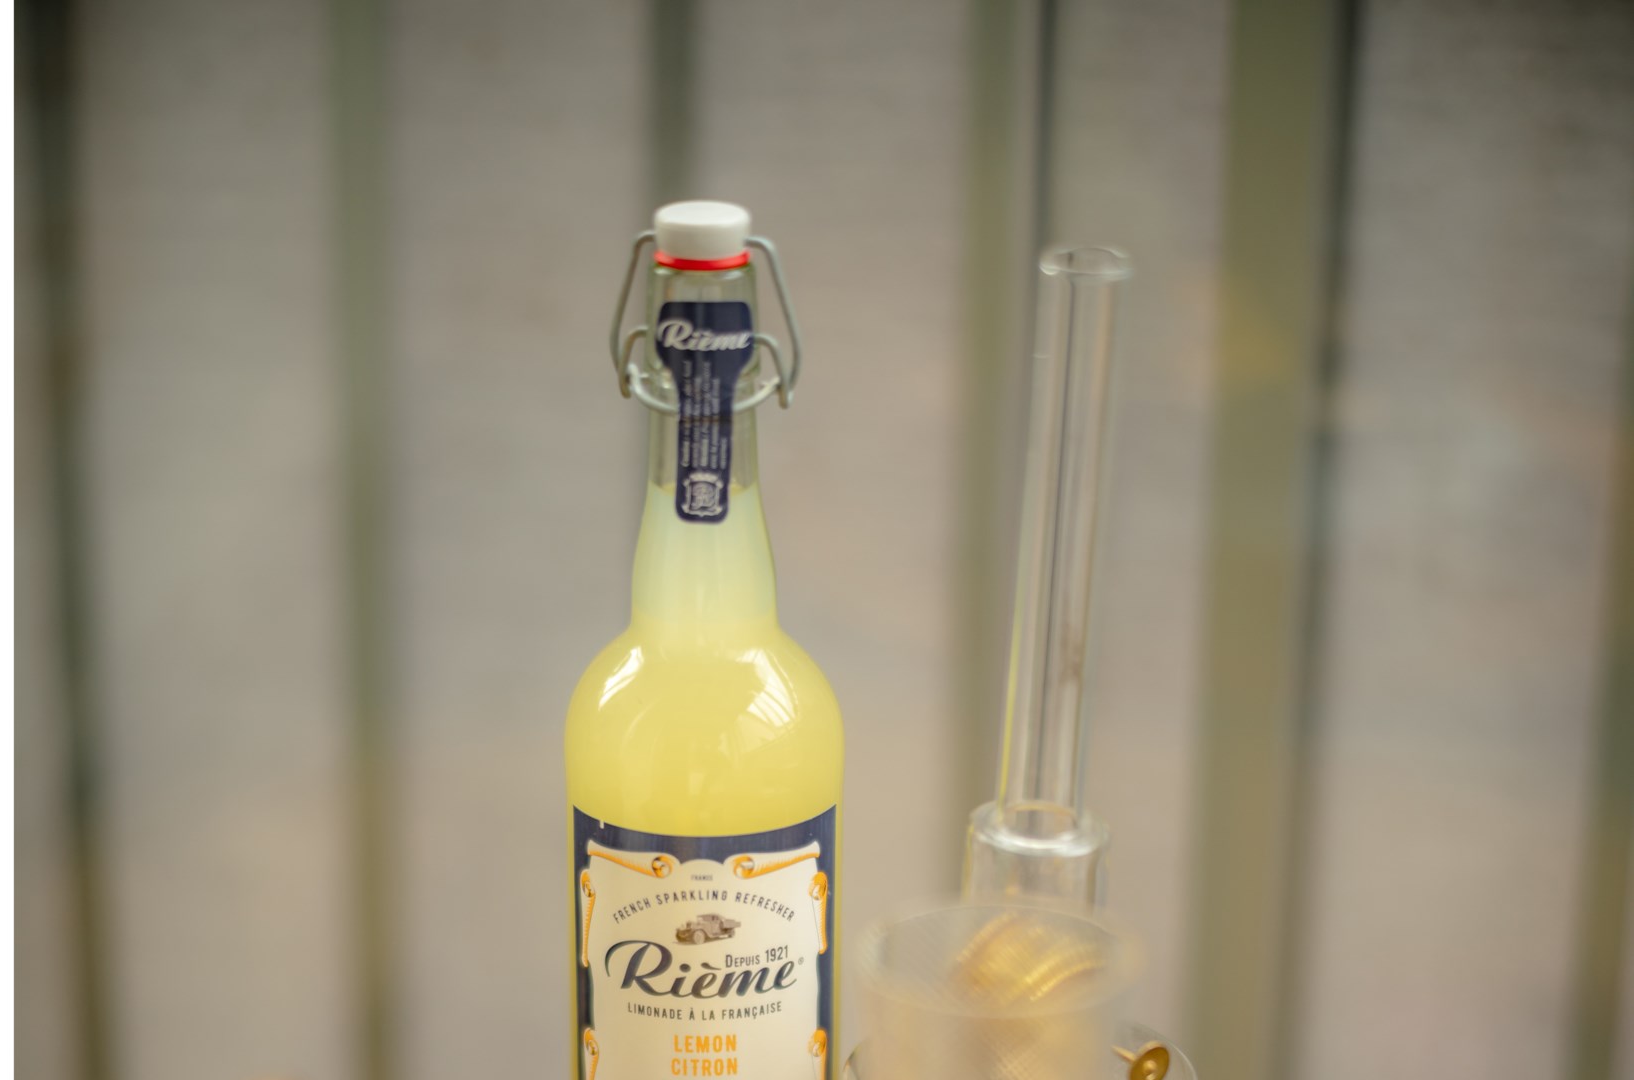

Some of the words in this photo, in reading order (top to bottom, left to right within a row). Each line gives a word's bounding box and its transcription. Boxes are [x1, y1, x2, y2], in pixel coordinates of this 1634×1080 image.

[613, 898, 651, 924] FRENCH
[655, 889, 727, 905] SPARKLING
[735, 891, 795, 922] REFRESHER
[765, 945, 789, 963] 1921
[604, 940, 797, 999] Rième
[628, 1002, 682, 1020] LIMONADE
[689, 1008, 695, 1021] À
[701, 1010, 715, 1021] LA
[722, 1001, 782, 1021] FRANÇAISE
[673, 1034, 737, 1053] LEMON
[670, 1057, 738, 1077] CITRON
